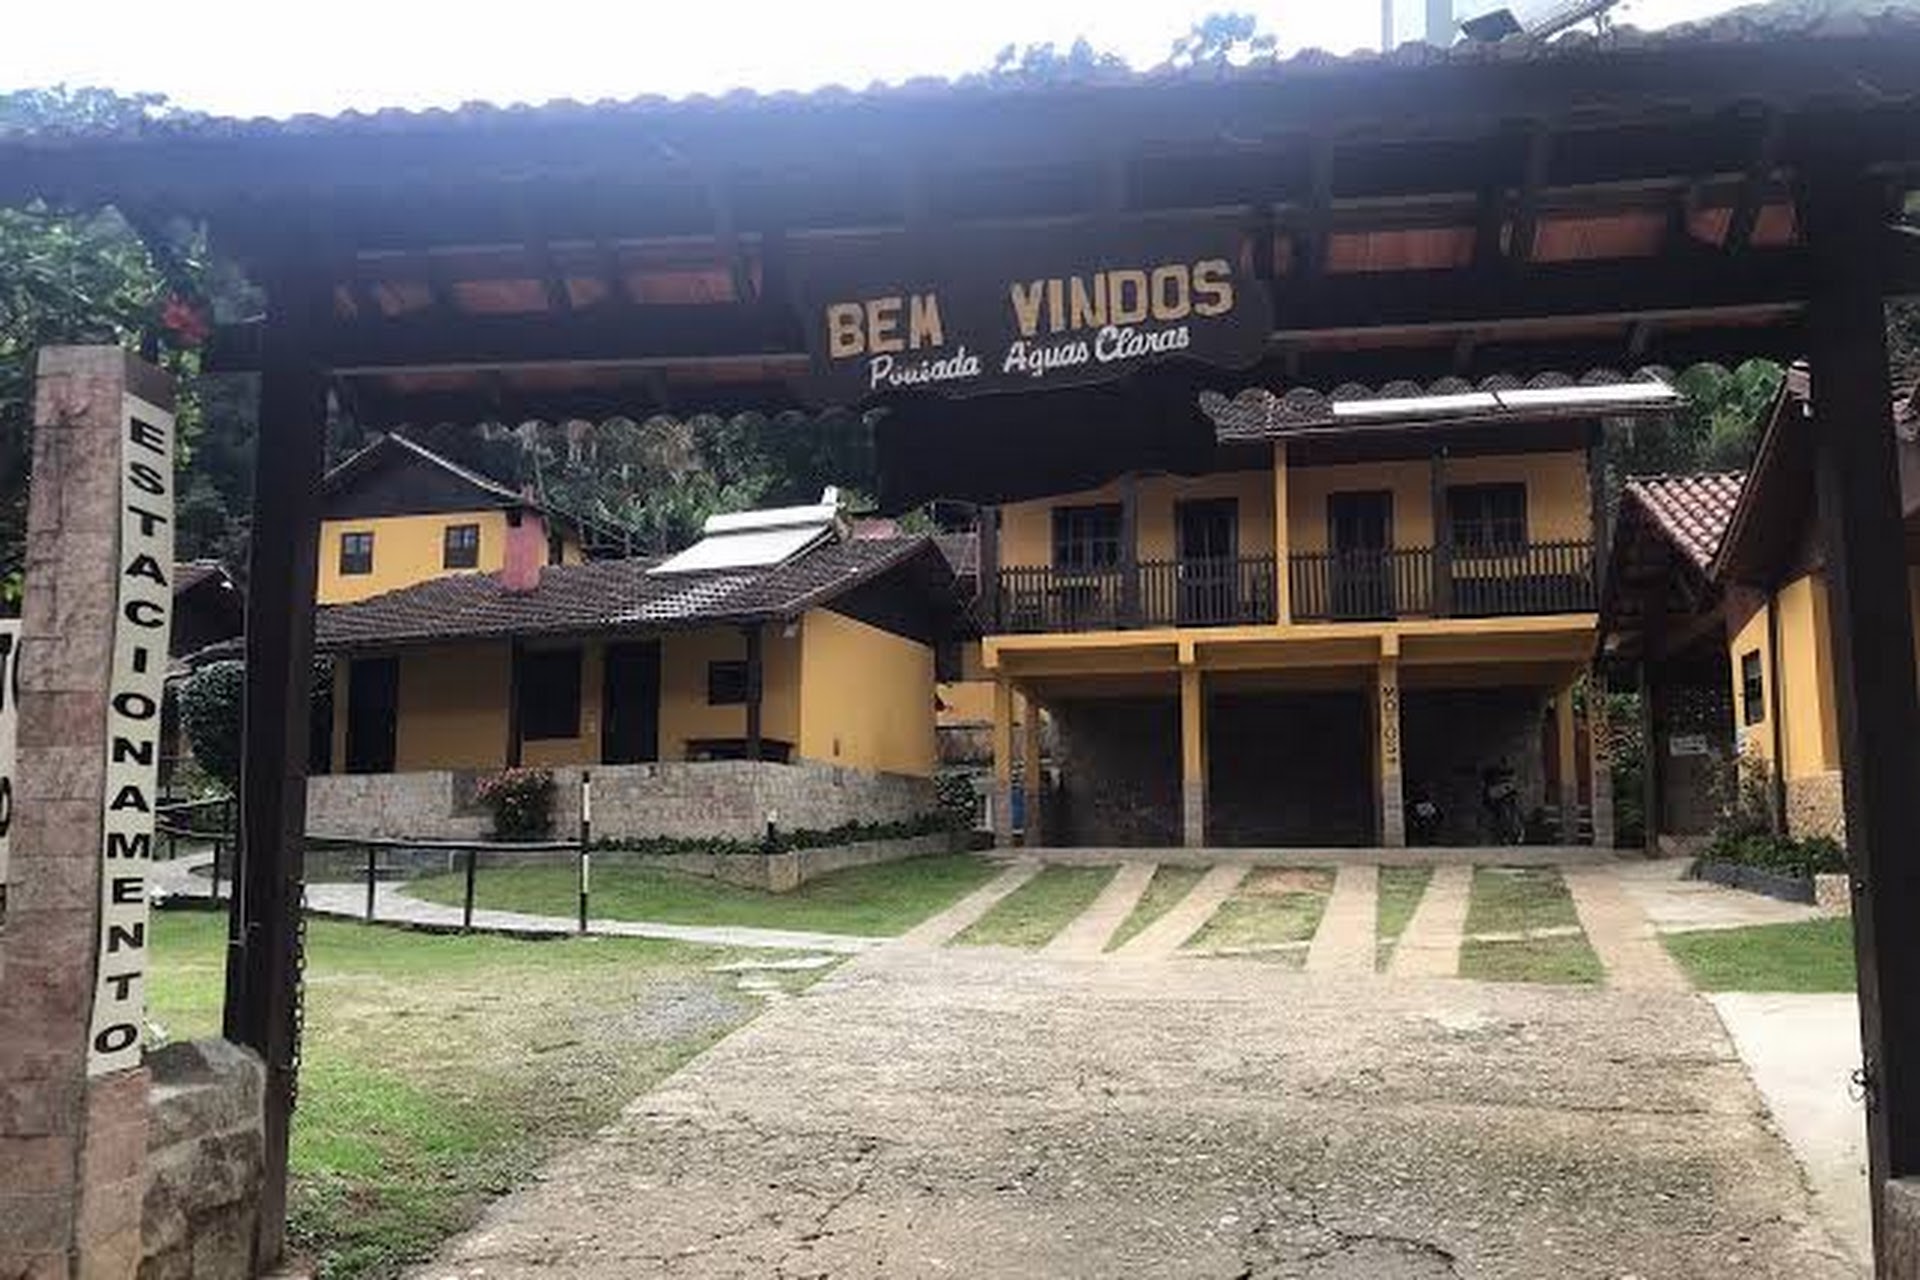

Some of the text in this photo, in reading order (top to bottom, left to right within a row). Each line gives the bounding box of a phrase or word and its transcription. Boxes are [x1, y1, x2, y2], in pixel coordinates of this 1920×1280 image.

[828, 258, 1233, 359] BEM VINDOS
[1094, 325, 1190, 363] Claras
[94, 416, 168, 1055] ESTACIONAMENTO
